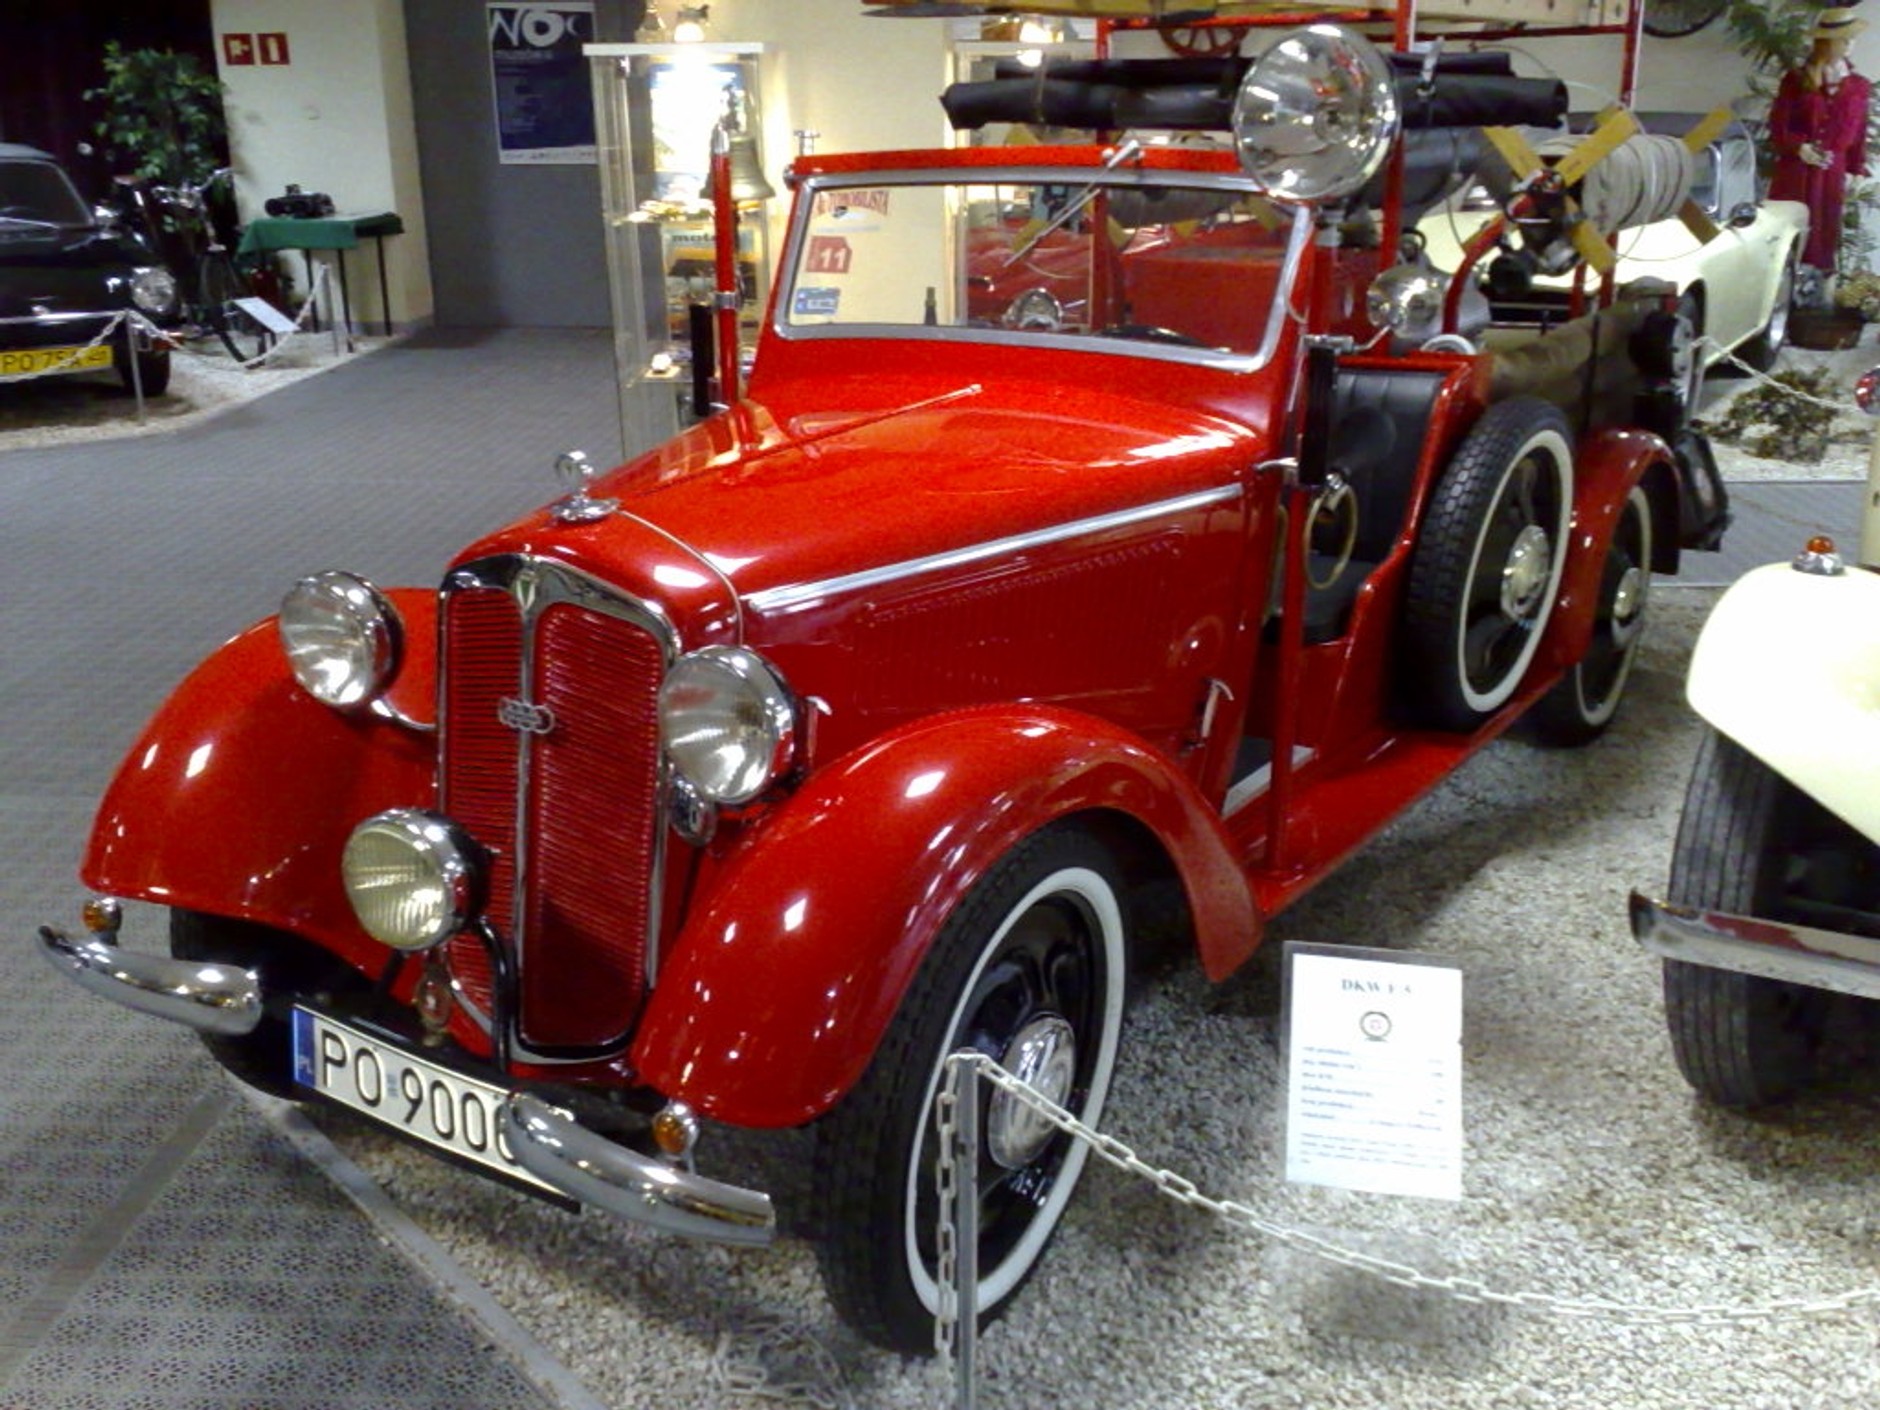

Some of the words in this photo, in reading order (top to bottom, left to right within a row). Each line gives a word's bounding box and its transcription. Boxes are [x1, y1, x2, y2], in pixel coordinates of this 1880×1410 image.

[820, 247, 847, 269] 11
[4, 354, 33, 373] PO
[321, 1029, 382, 1107] PO
